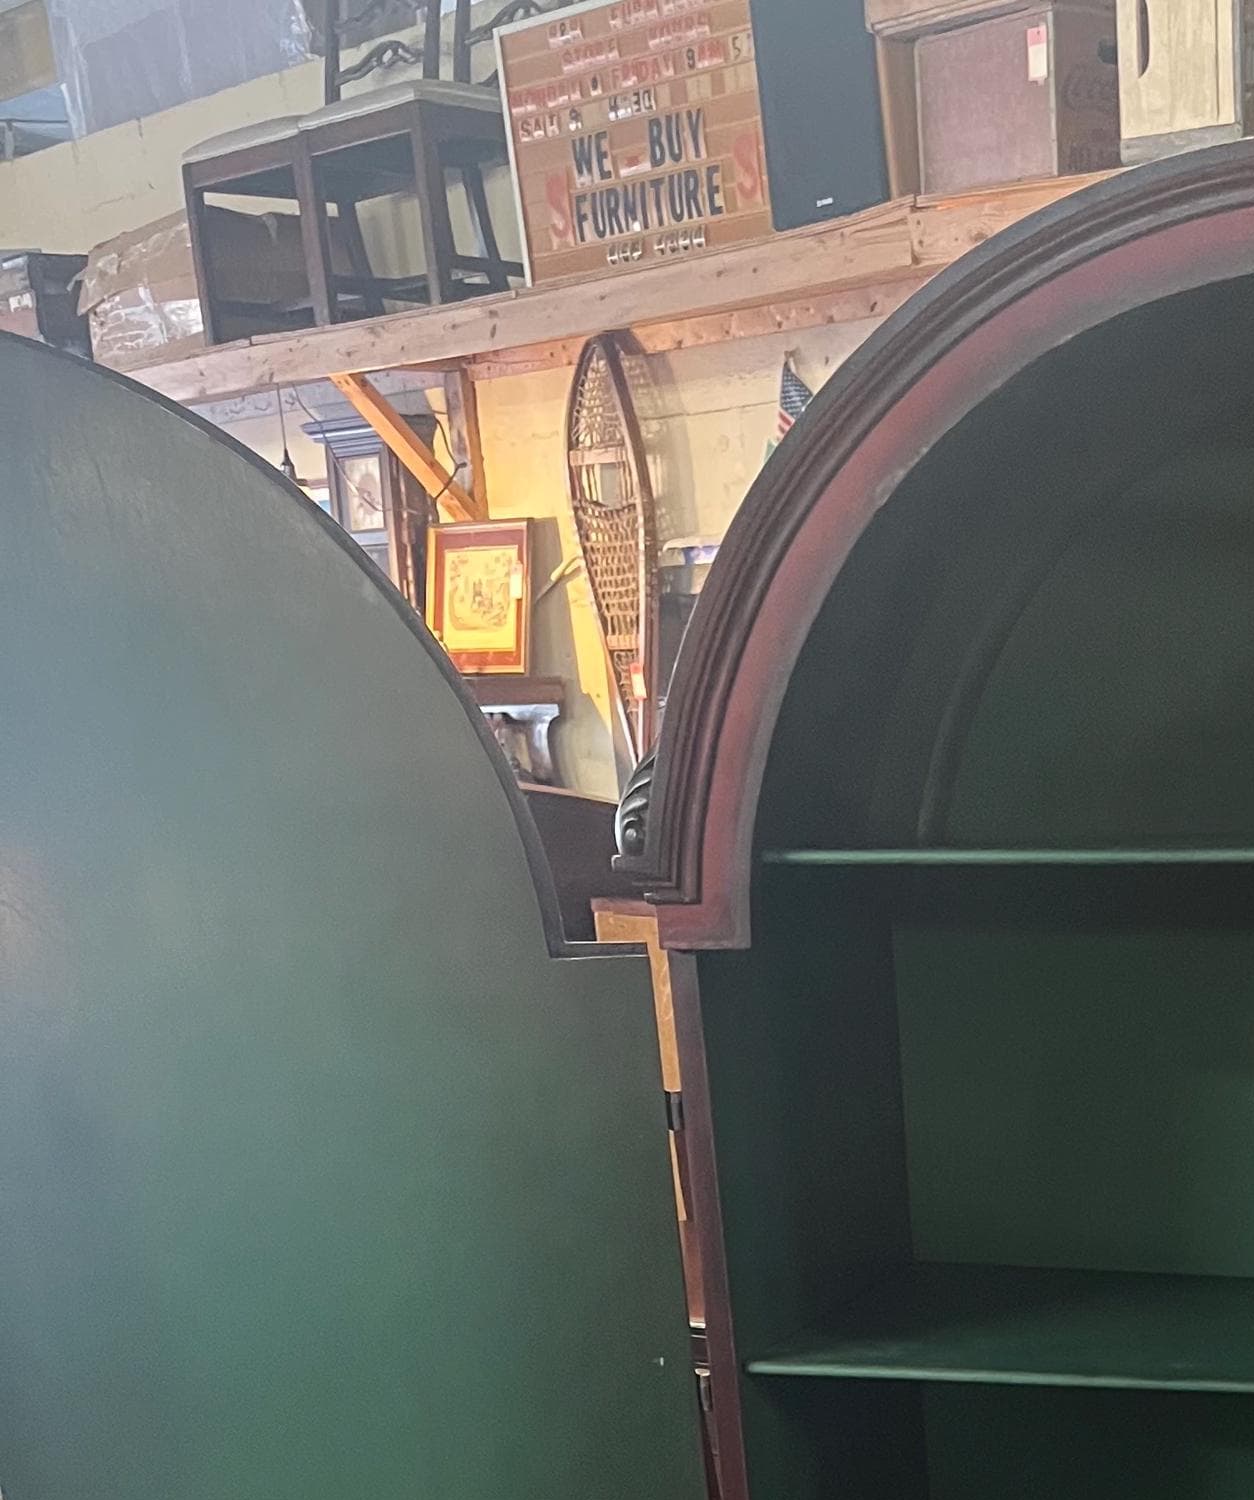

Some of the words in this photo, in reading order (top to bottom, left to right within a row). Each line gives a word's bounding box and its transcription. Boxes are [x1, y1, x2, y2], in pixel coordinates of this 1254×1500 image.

[571, 131, 612, 184] WE
[648, 108, 703, 167] BUY
[575, 164, 724, 243] FURNITURE
